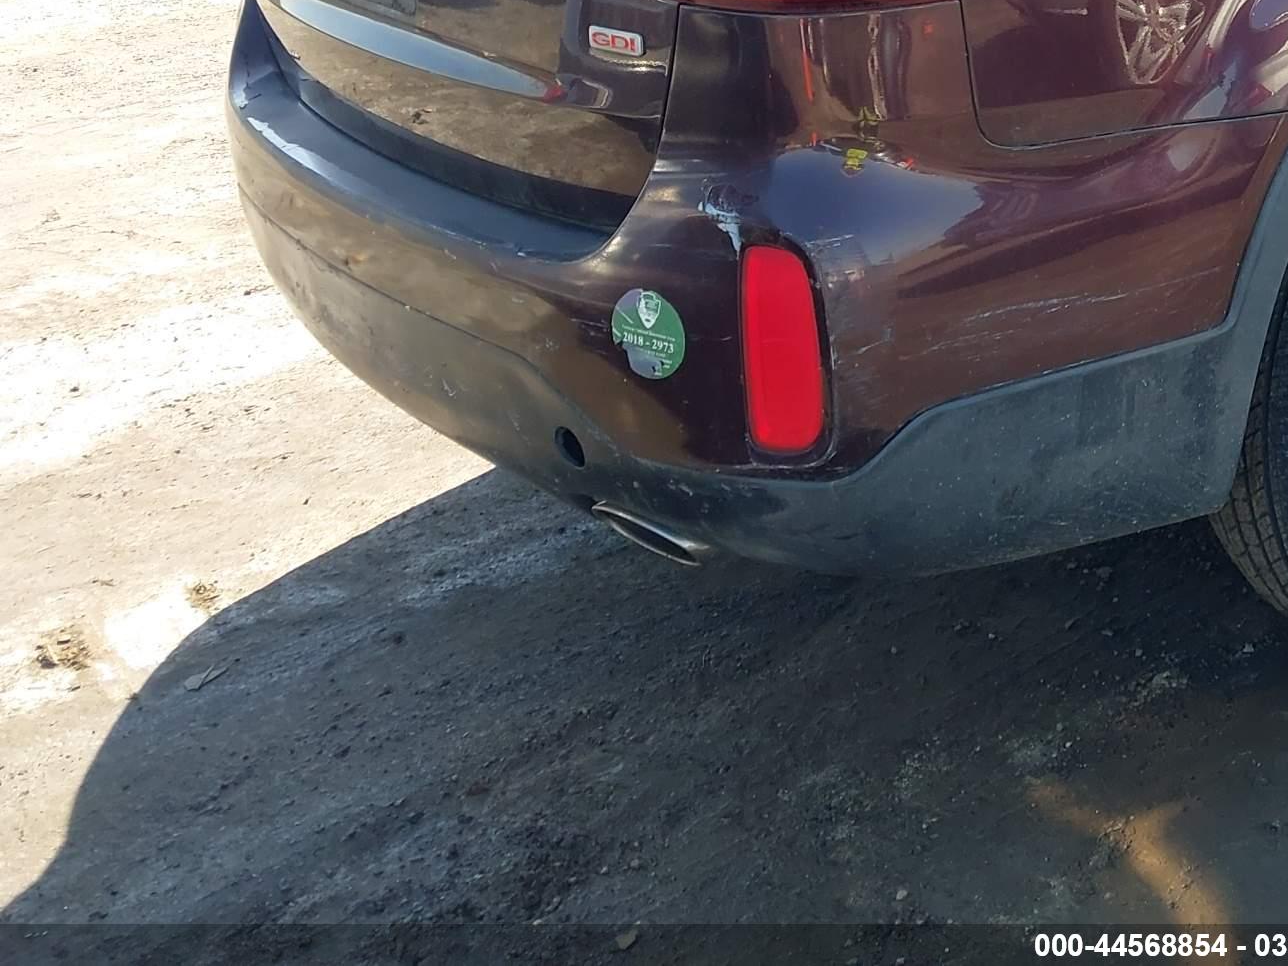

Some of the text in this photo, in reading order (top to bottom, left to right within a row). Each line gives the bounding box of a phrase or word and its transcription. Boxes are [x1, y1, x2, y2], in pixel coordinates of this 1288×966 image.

[592, 32, 636, 52] GDI
[622, 331, 644, 347] 2018
[651, 339, 674, 354] 2973
